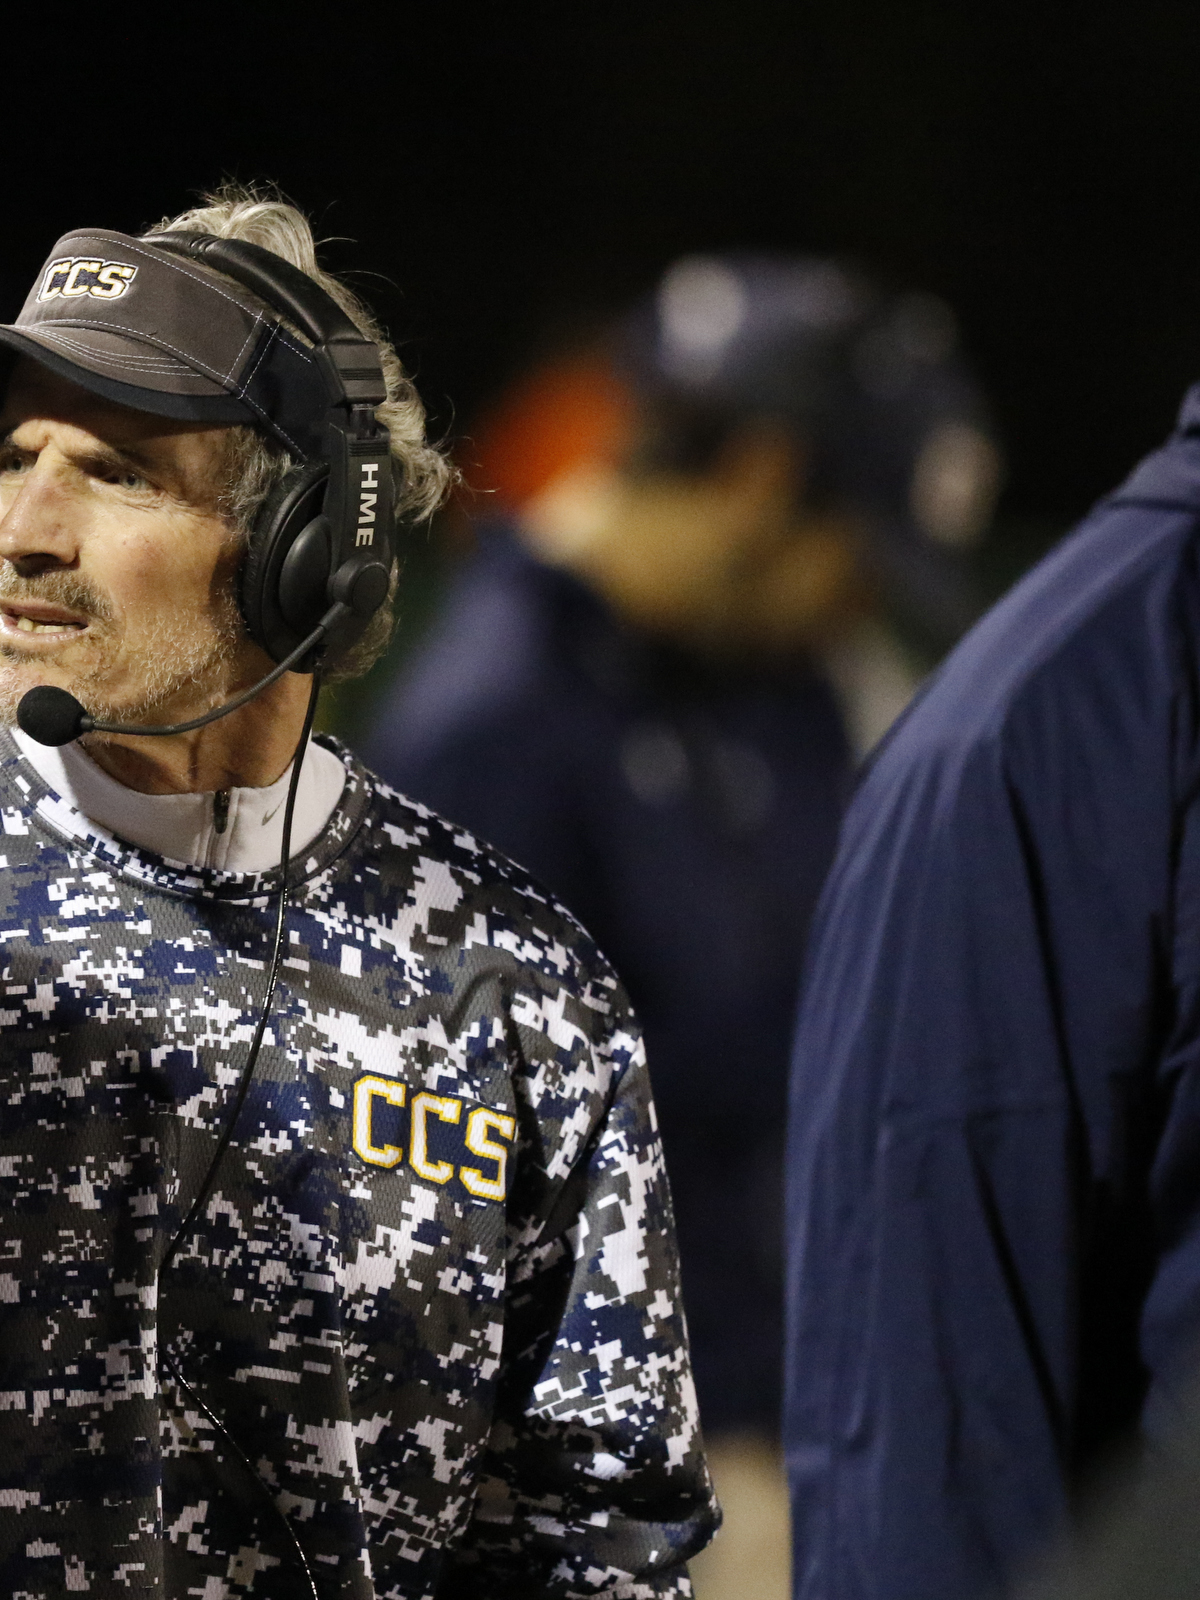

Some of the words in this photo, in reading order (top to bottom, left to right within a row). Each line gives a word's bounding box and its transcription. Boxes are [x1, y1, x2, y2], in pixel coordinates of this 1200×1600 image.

[37, 257, 138, 302] CCS
[355, 463, 379, 547] HME
[352, 1074, 516, 1202] CCS
